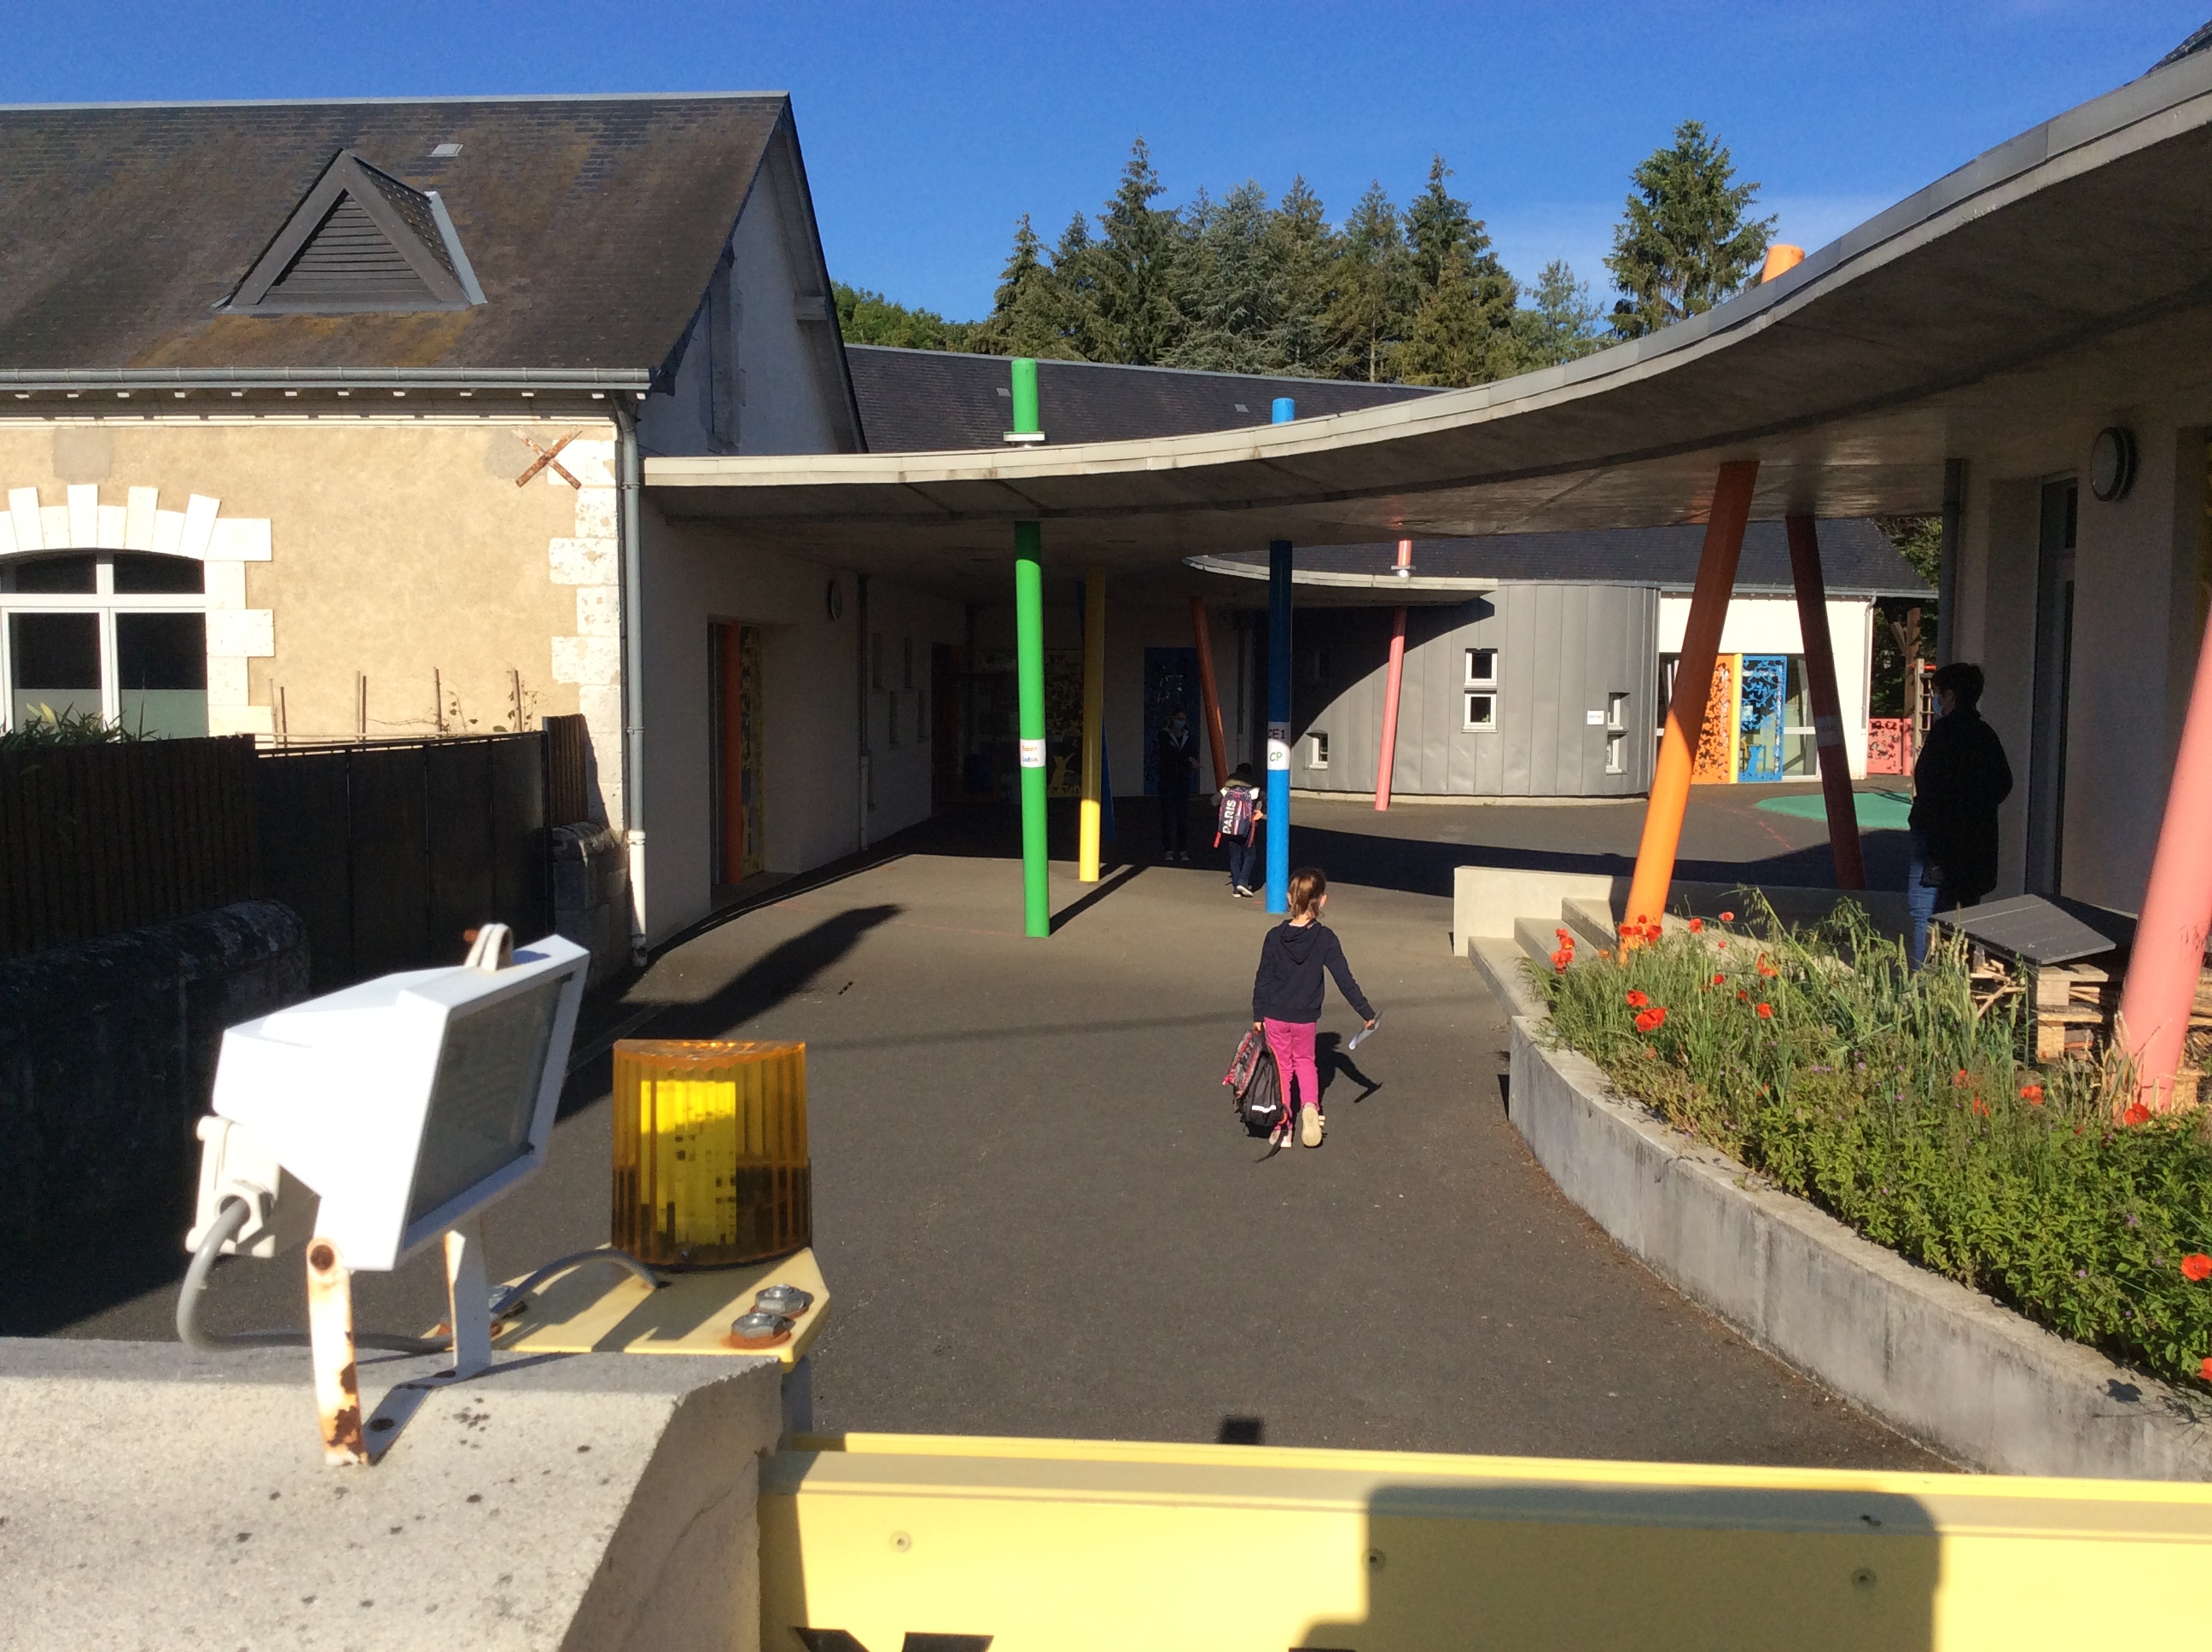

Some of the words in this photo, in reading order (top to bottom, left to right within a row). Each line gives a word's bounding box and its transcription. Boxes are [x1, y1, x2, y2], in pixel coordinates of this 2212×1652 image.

[1267, 729, 1285, 740] CE1
[1270, 752, 1283, 762] CP
[1222, 800, 1237, 835] PARIS
